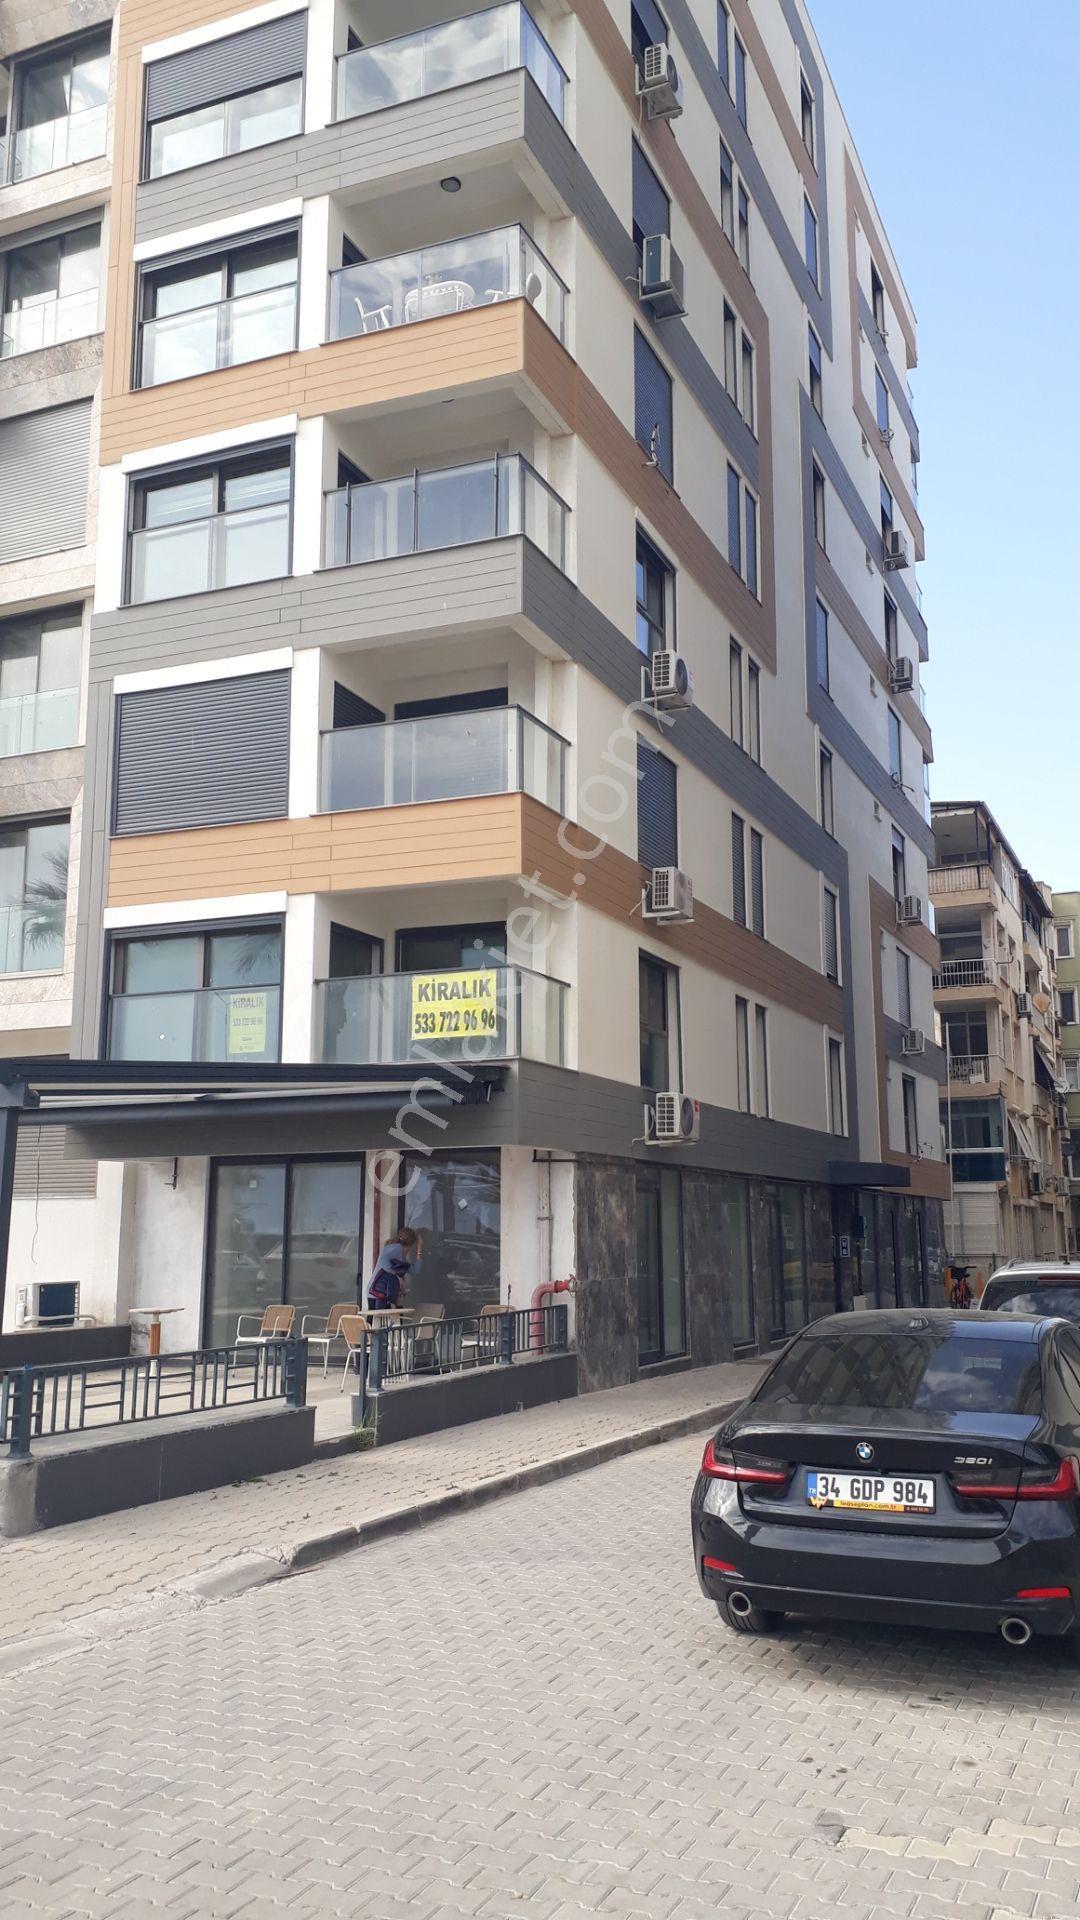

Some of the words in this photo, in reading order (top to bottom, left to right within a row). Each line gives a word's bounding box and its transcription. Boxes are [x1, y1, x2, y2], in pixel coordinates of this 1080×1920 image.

[418, 978, 492, 1003] KİRALIK
[414, 1012, 436, 1034] 533
[439, 1010, 460, 1032] 722
[463, 1009, 477, 1031] 96
[481, 1008, 495, 1030] 96
[808, 1487, 817, 1495] TR
[819, 1476, 841, 1498] 34
[850, 1478, 885, 1501] GDP
[892, 1481, 928, 1504] 984
[839, 1500, 897, 1510] leaseplan.com.tr
